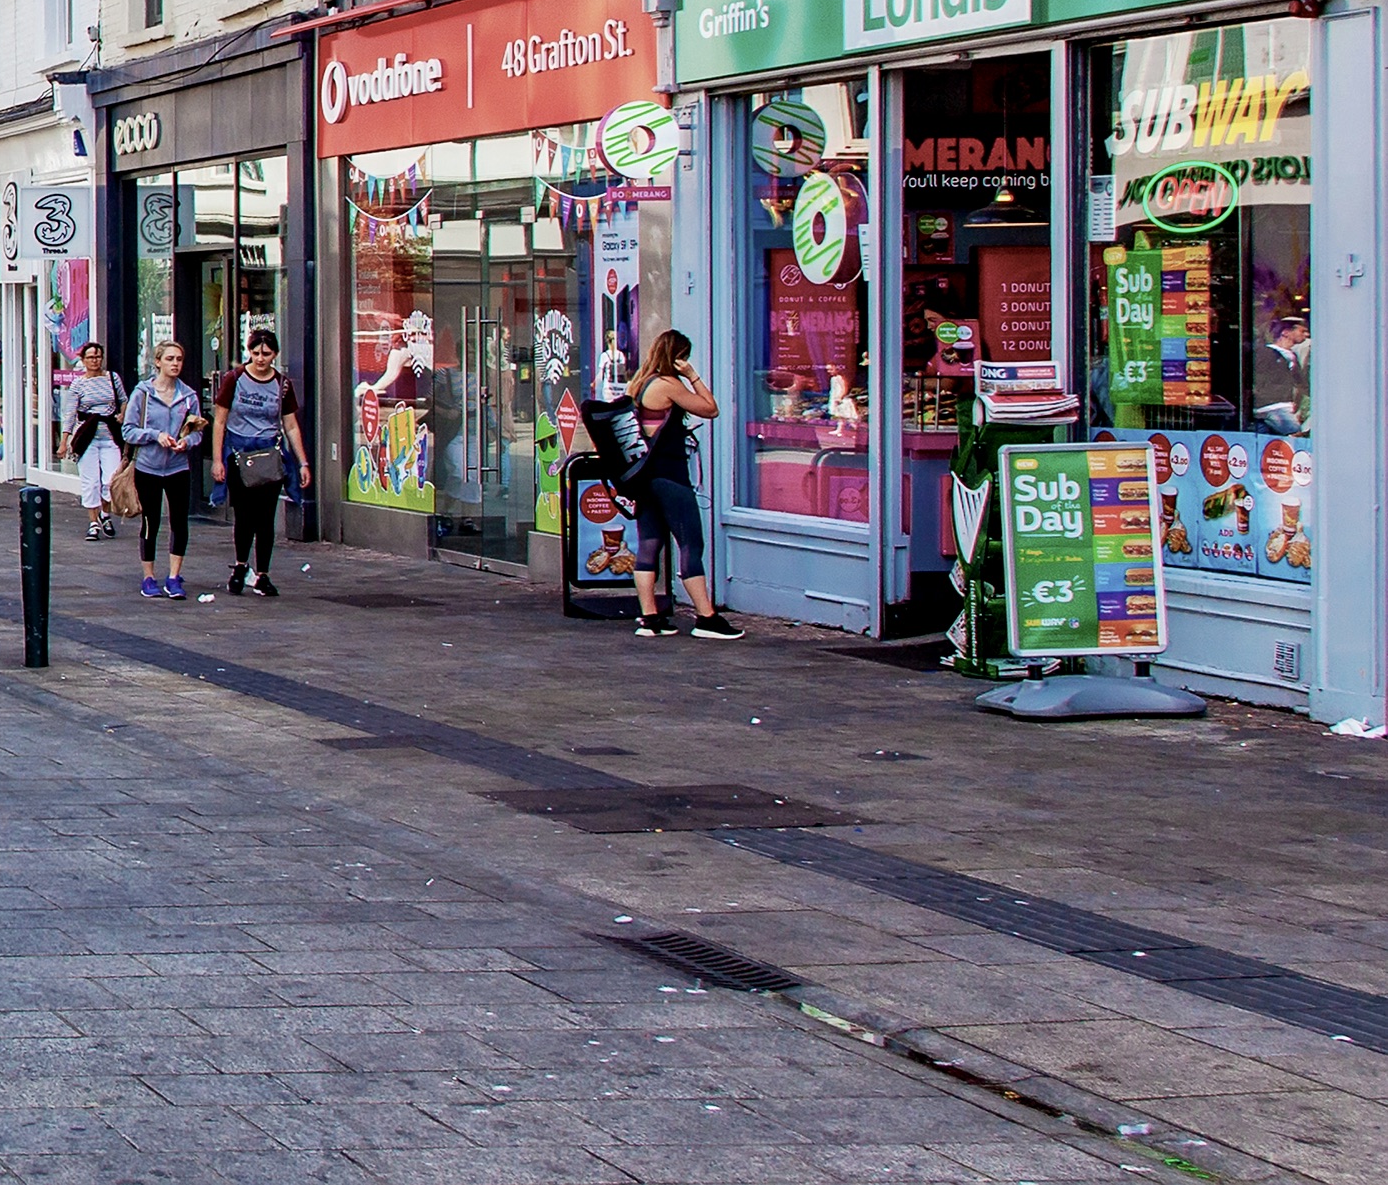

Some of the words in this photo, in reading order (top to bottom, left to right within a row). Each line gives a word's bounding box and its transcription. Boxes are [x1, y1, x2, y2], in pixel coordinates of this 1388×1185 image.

[501, 38, 526, 78] 48
[528, 28, 602, 74] Grafton
[603, 19, 634, 61] St.
[347, 52, 443, 107] vodafone
[1104, 70, 1311, 159] SUBWAY
[114, 112, 159, 155] ecco
[941, 173, 979, 189] keep
[982, 173, 1037, 190] coming
[1157, 176, 1228, 217] OPEN
[34, 193, 76, 247] 3
[42, 247, 68, 255] Three.ie
[1001, 282, 1007, 293] 1
[1012, 282, 1051, 293] DONUT
[1115, 266, 1153, 294] Sub
[1001, 301, 1008, 312] 3
[1012, 302, 1051, 312] DONUT
[1116, 298, 1154, 330] Day
[1001, 321, 1008, 332] 6
[1012, 321, 1051, 332] DONUT
[1002, 340, 1016, 351] 12
[981, 368, 1007, 379] DNG
[1125, 360, 1147, 383] €3
[1014, 473, 1080, 502] Sub
[1051, 502, 1062, 510] of
[1064, 502, 1081, 510] the
[1016, 505, 1083, 539] Day
[1218, 529, 1234, 537] ADD
[1032, 580, 1074, 603] €3
[1025, 618, 1066, 628] SUBWAY
